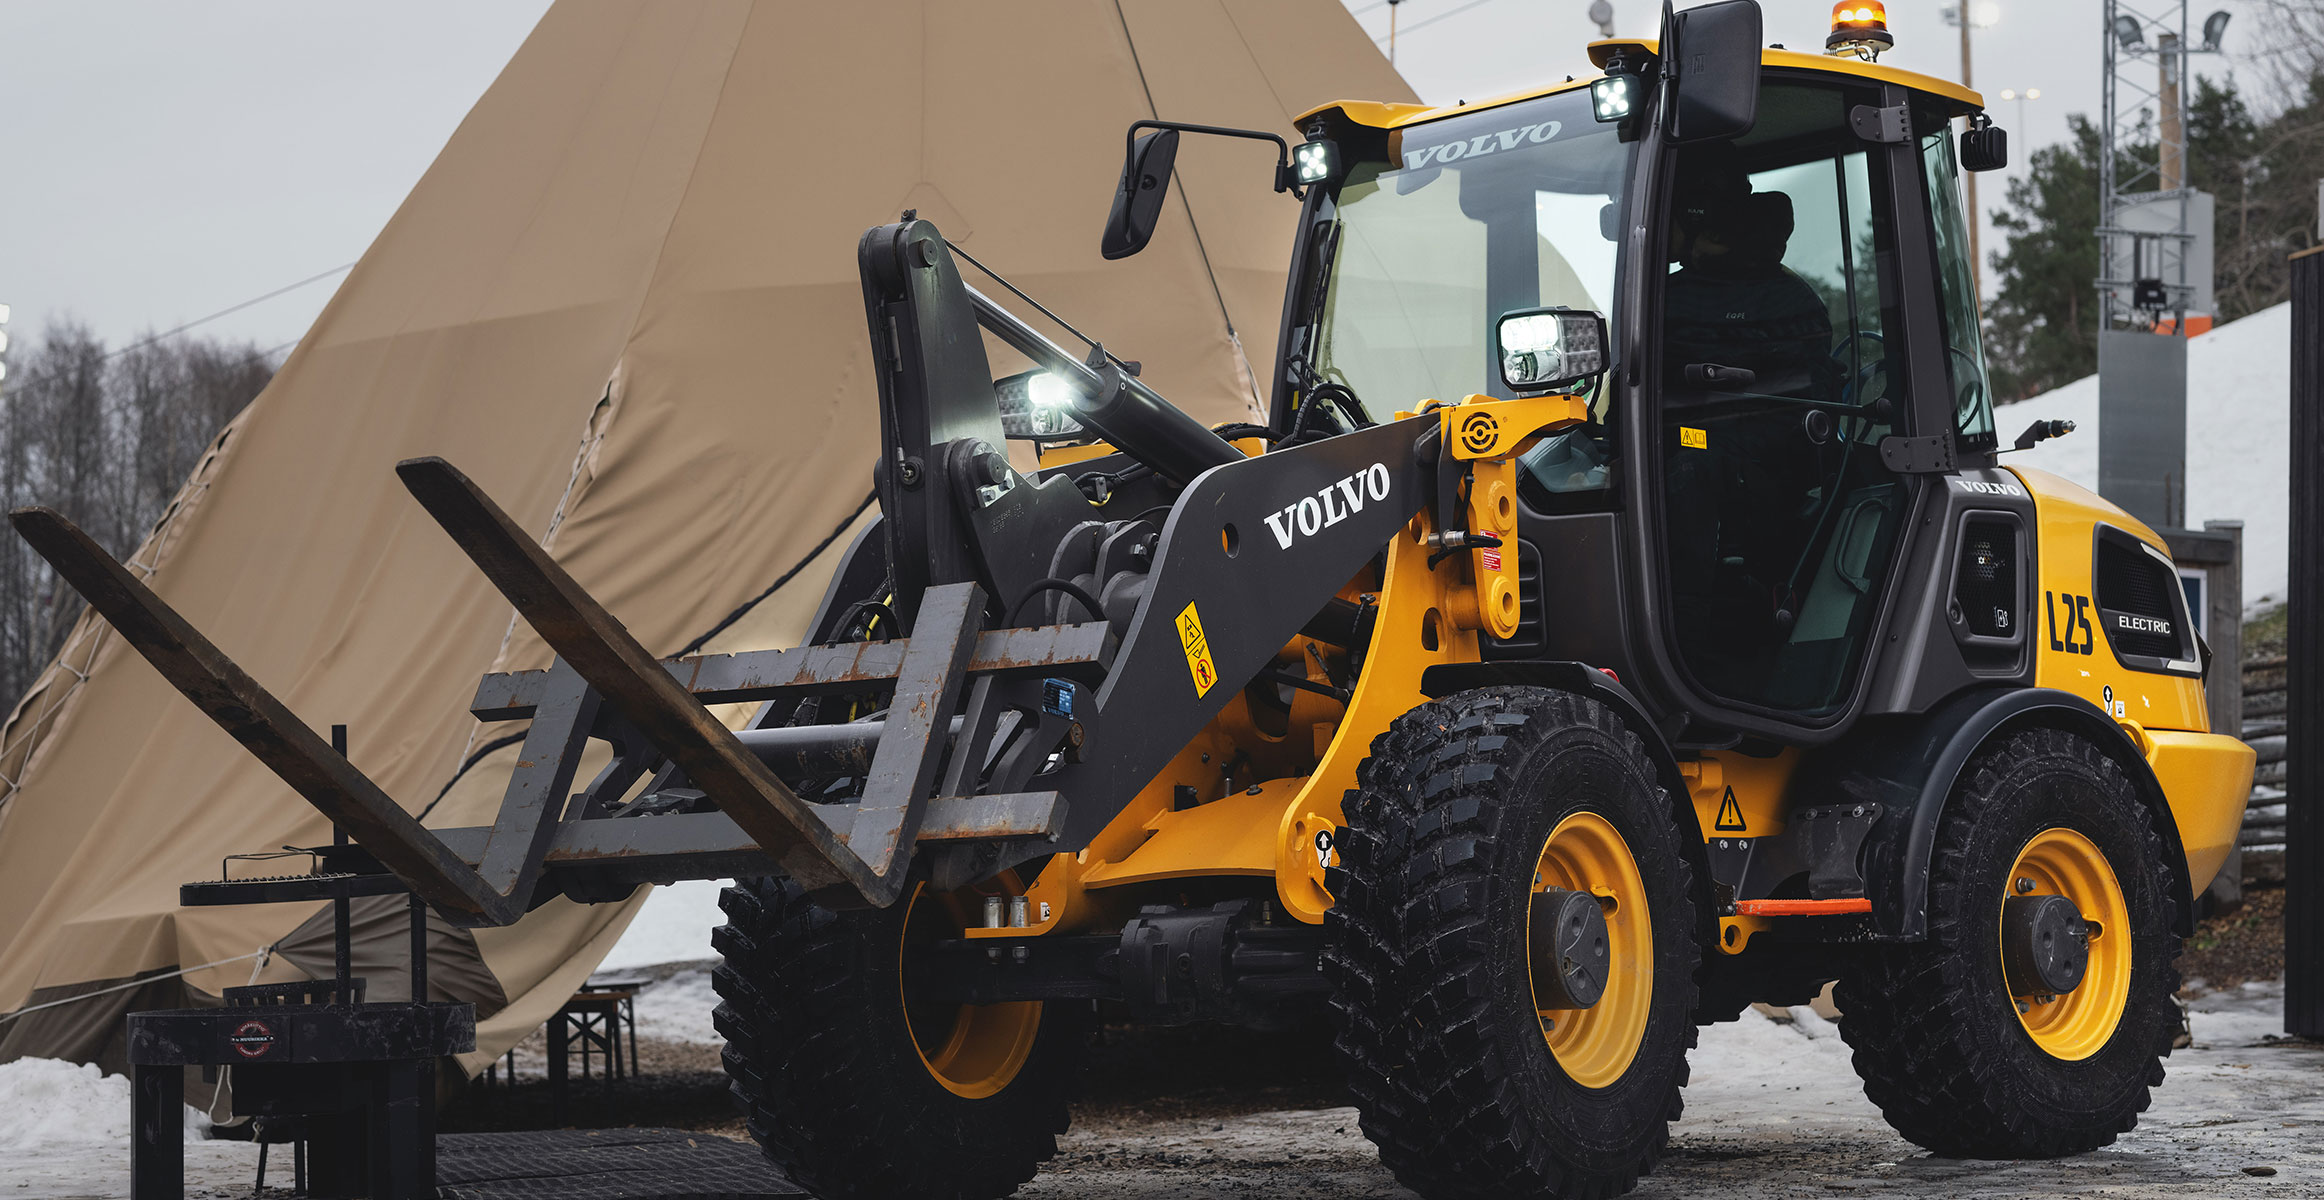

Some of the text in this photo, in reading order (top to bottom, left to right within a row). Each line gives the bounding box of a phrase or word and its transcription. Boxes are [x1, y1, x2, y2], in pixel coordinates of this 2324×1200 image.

[1404, 120, 1562, 170] VOLVO
[1264, 462, 1391, 550] VOLVO
[1955, 480, 2021, 496] VOLVO
[2045, 590, 2094, 656] L25
[2118, 615, 2171, 634] ELECTRIC
